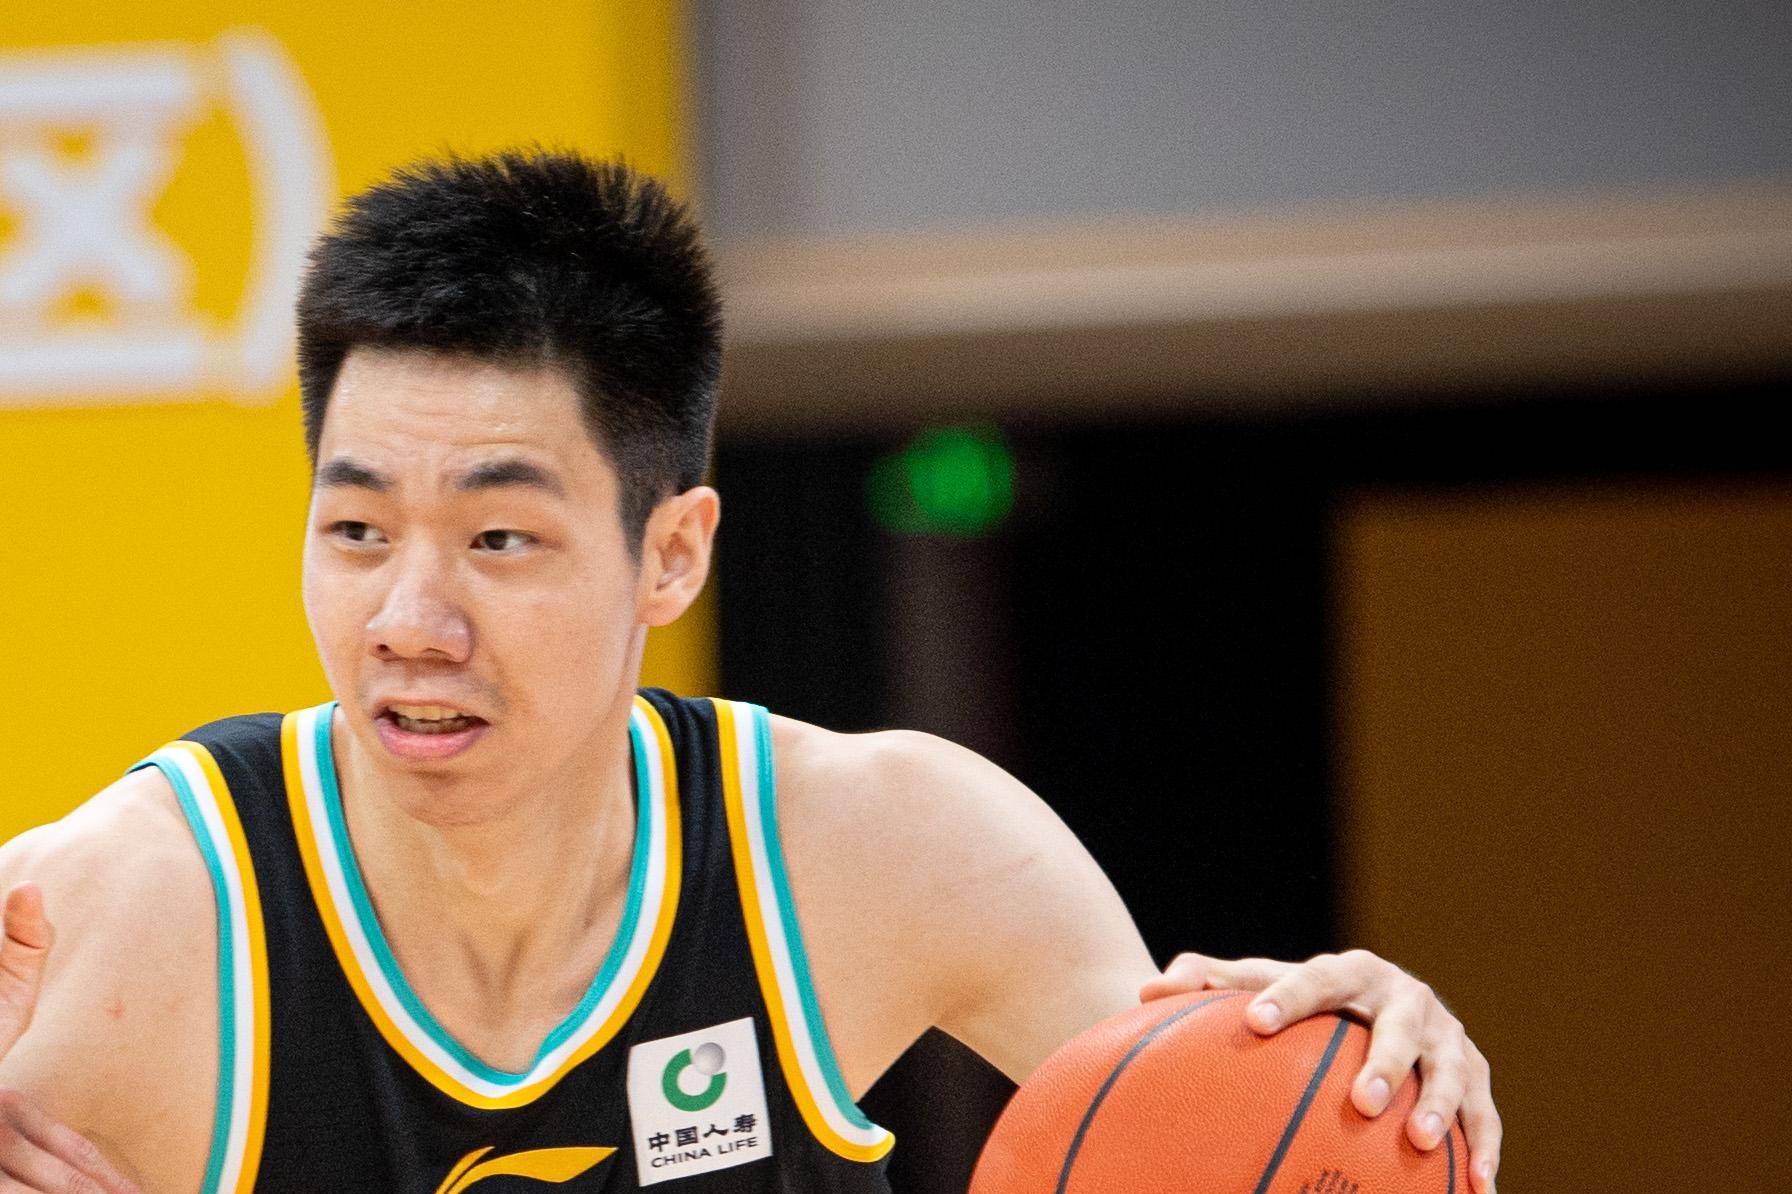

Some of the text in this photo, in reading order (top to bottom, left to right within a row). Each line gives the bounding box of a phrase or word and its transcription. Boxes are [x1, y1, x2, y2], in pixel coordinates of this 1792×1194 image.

[647, 1113, 758, 1153] 中国人寿
[650, 1136, 759, 1168] CHINA LIFE
